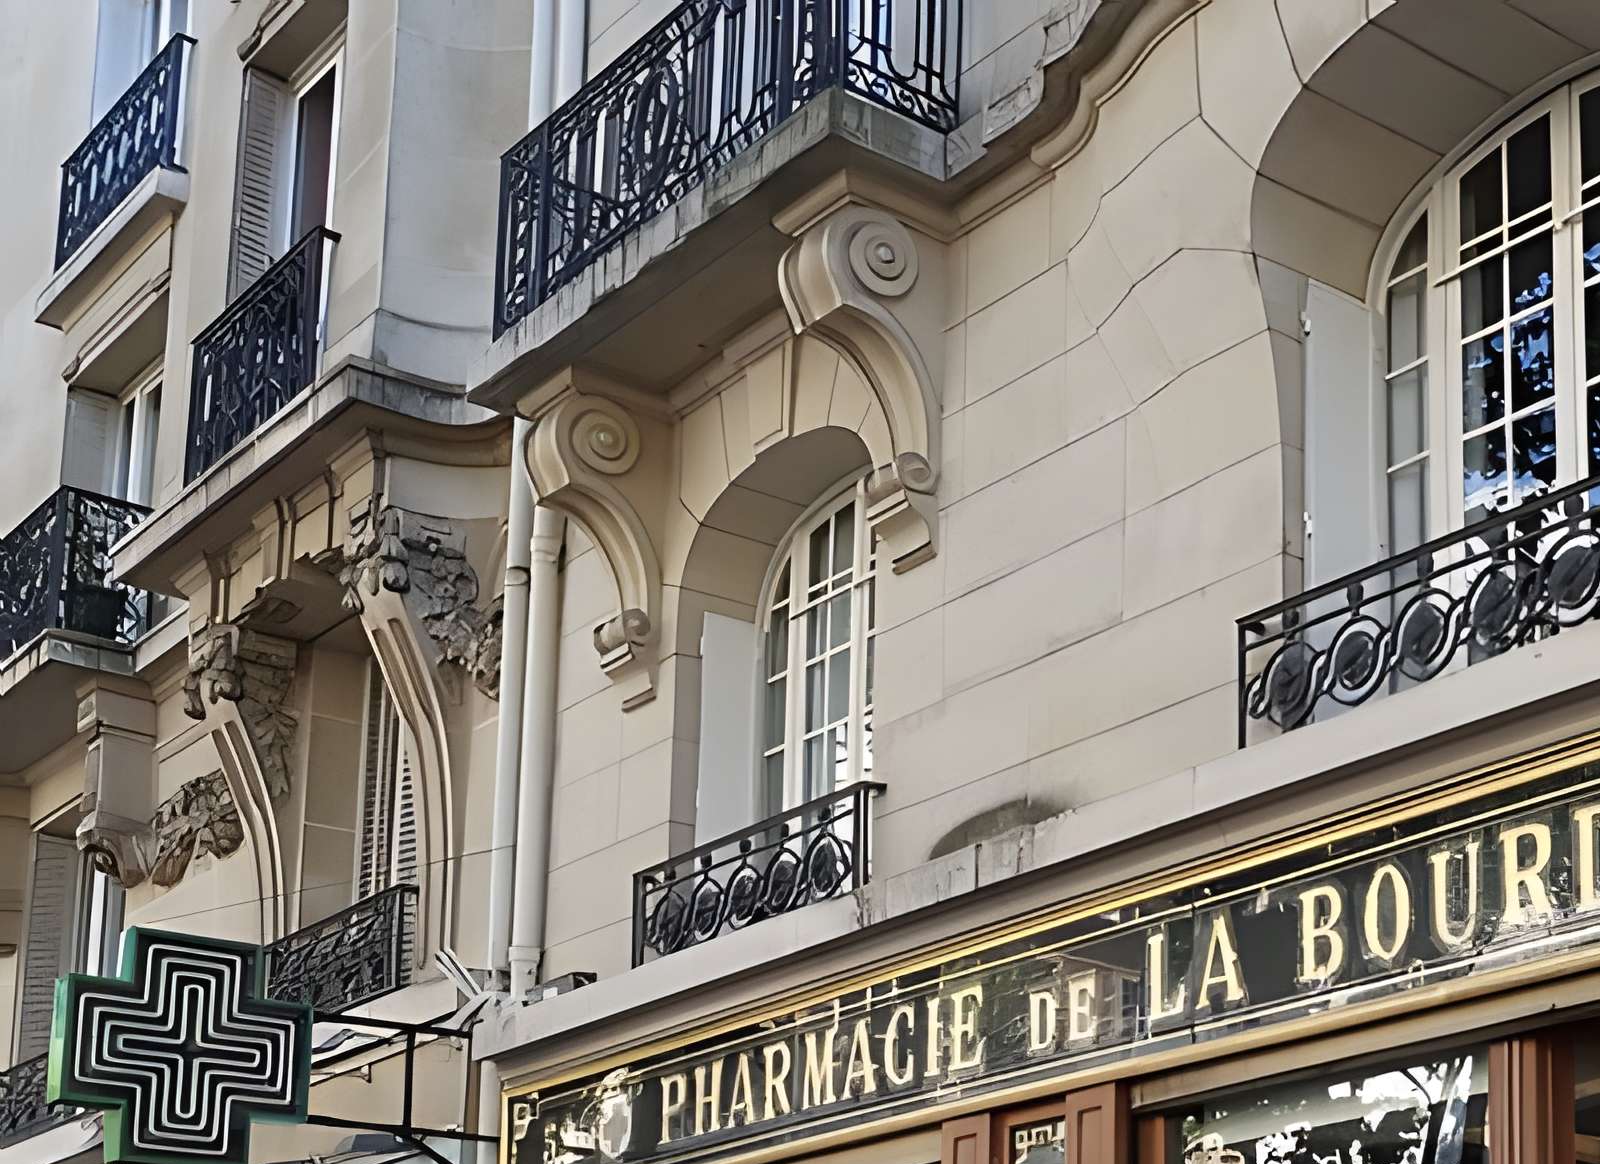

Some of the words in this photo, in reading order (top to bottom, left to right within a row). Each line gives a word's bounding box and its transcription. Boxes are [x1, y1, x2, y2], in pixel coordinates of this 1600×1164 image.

[656, 984, 986, 1147] PHARMACIE
[1028, 968, 1098, 1051] DE
[1147, 914, 1248, 1021] LA
